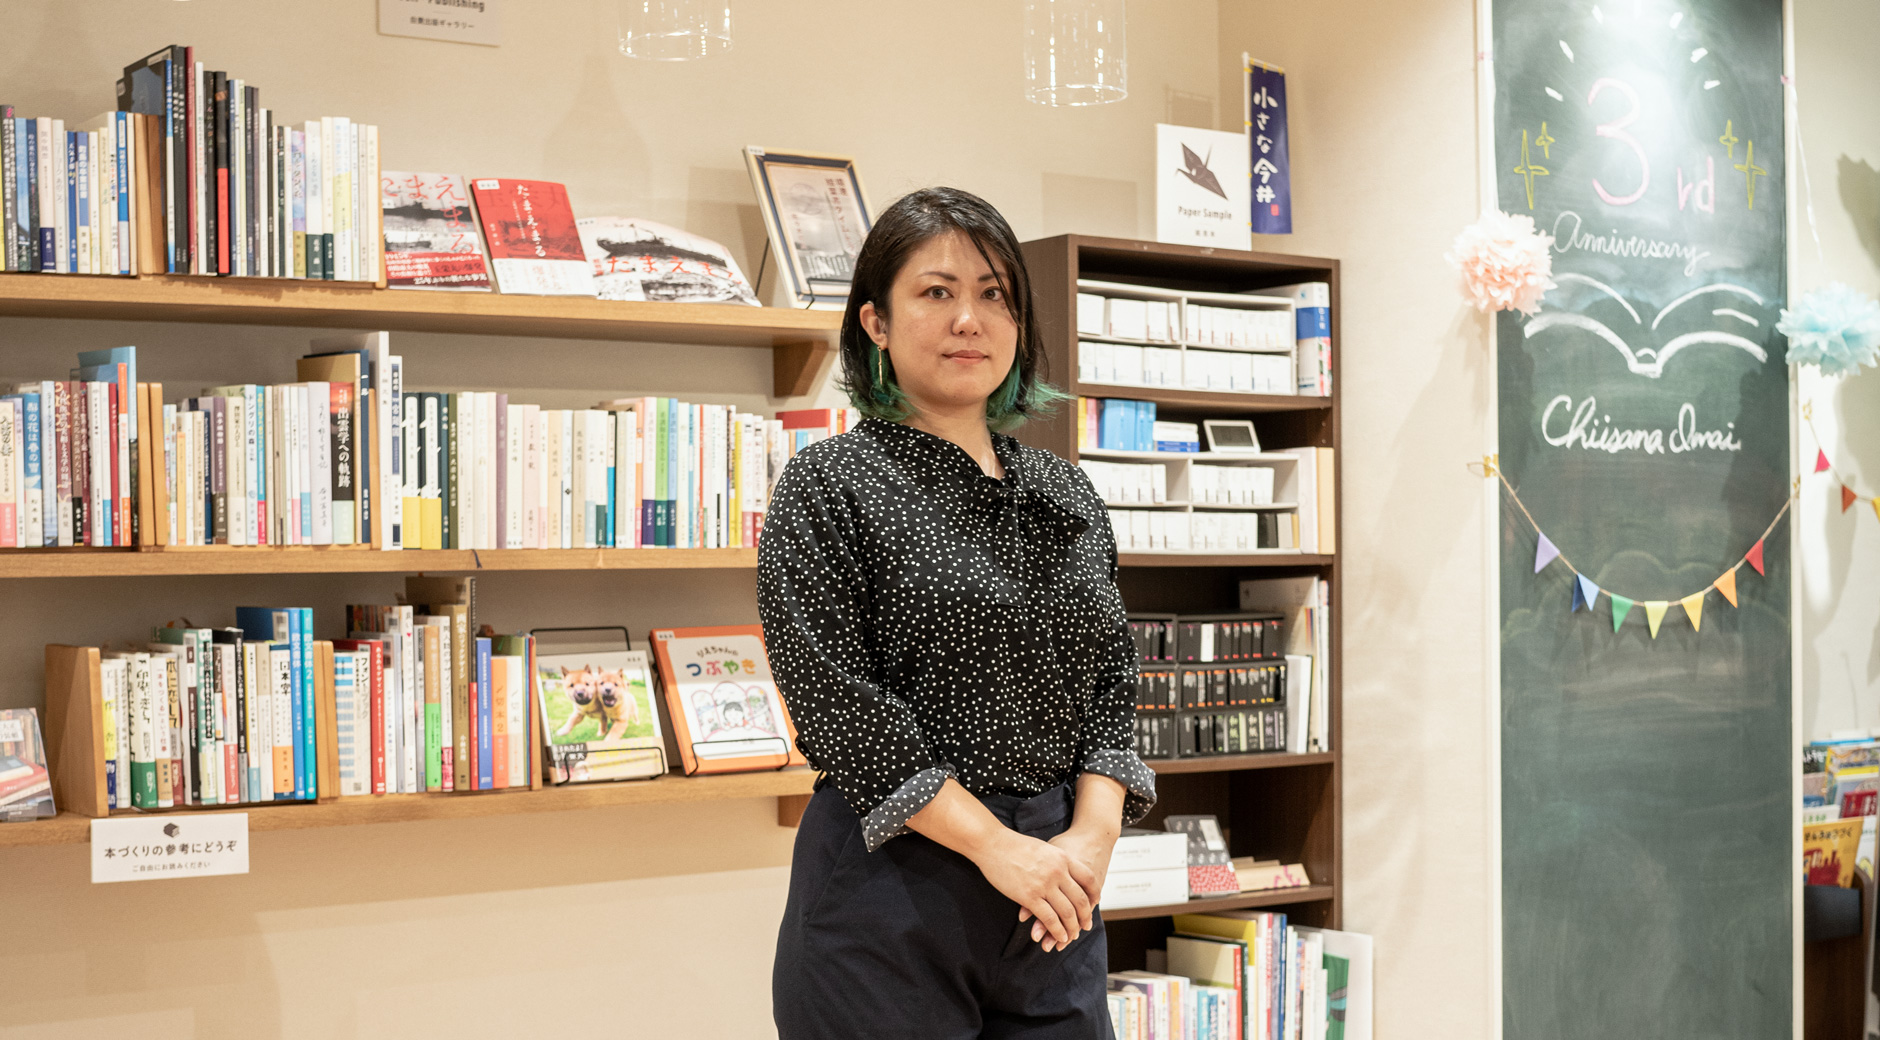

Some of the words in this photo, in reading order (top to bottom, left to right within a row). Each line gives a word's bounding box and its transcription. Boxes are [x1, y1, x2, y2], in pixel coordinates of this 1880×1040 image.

[1253, 86, 1278, 204] 小さな今井
[1178, 206, 1201, 218] Paper
[1204, 208, 1232, 221] Sample
[1552, 211, 1711, 276] Anniversary
[337, 407, 350, 488] 出雲学への軌跡
[1541, 394, 1665, 455] Chiisana
[166, 660, 178, 729] 本に恋して
[361, 657, 369, 719] フォントブック
[686, 658, 756, 677] つぶやき
[104, 840, 237, 859] 本づくりの参考にどうぞ
[132, 861, 211, 873] ご自由にお読みください
